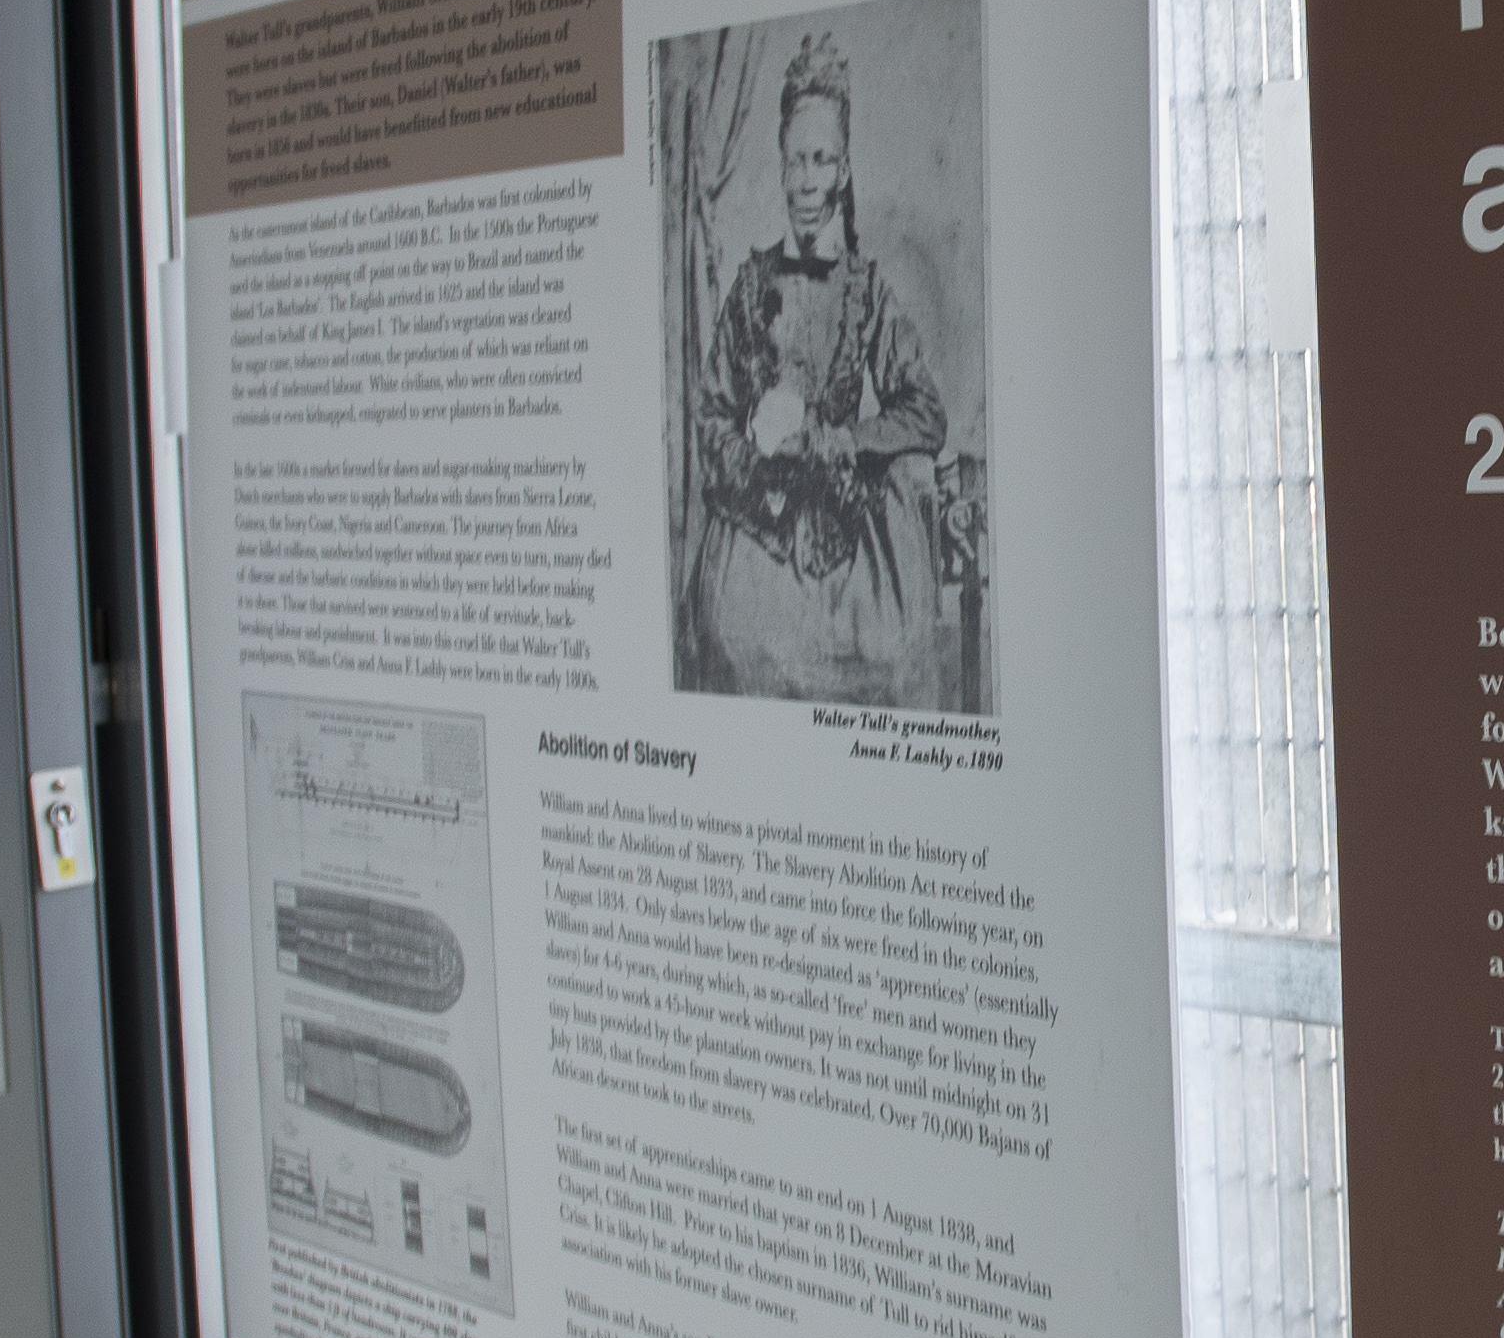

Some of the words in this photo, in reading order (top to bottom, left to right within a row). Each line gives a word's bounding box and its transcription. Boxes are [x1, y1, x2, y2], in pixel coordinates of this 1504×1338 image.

[813, 707, 857, 728] Walter
[901, 718, 1001, 746] grandmother,
[538, 731, 609, 760] Abolition
[612, 739, 630, 763] of
[633, 740, 697, 777] Slavery
[850, 739, 885, 760] Anna
[905, 744, 952, 772] Lashly
[539, 789, 584, 815] William
[586, 799, 610, 819] and
[612, 800, 646, 824] Anna
[647, 804, 678, 829] lived
[680, 813, 694, 830] to
[696, 813, 743, 837] witness
[745, 824, 754, 838] a
[756, 823, 803, 845] pivotal
[806, 831, 865, 853] moment
[869, 832, 884, 856] in
[888, 835, 911, 858] the
[915, 838, 968, 872] history
[971, 846, 990, 870] of
